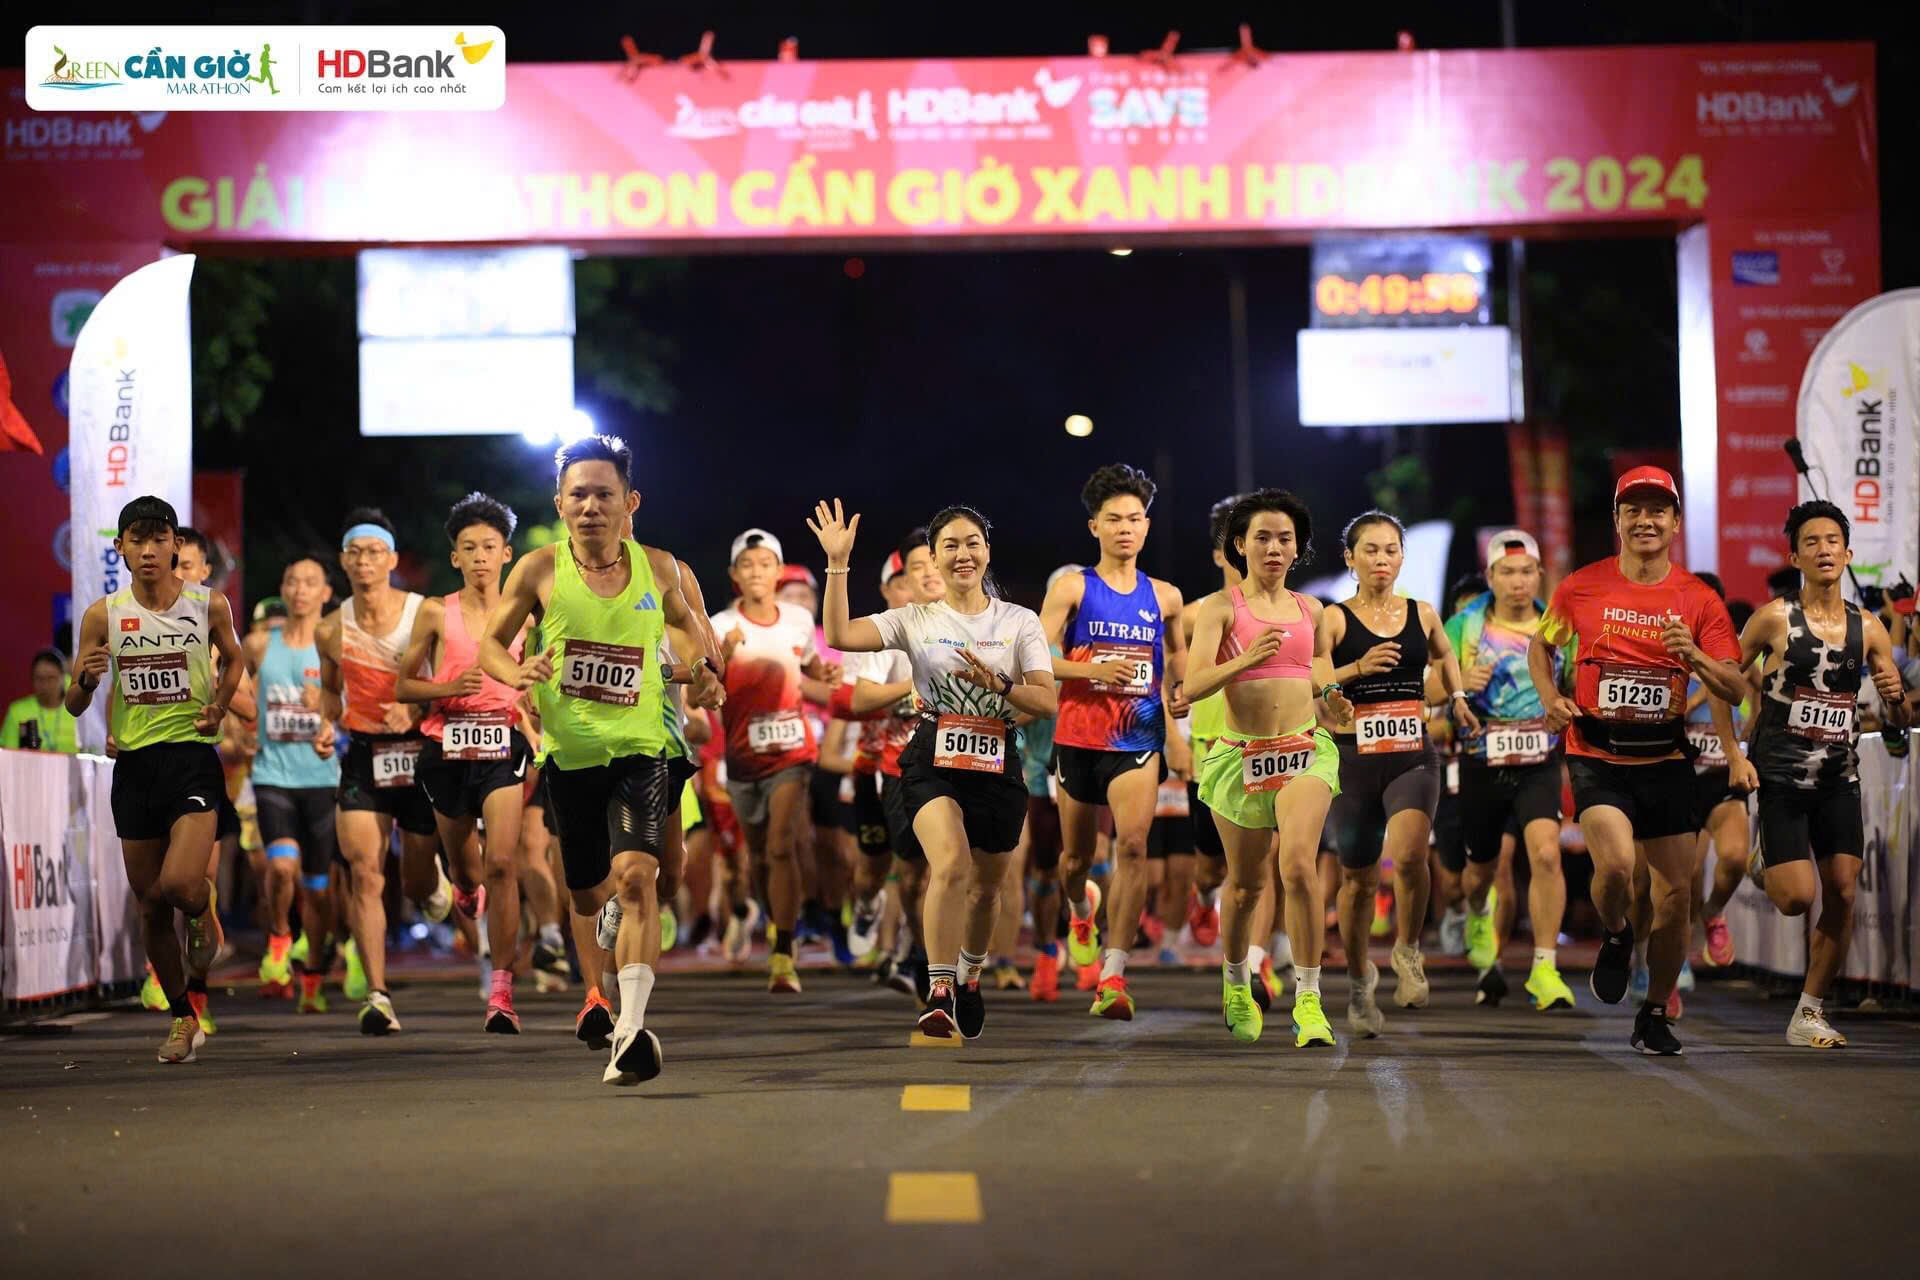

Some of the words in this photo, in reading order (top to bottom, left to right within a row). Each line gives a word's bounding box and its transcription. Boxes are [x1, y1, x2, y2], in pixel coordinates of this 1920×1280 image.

[5, 116, 132, 146] HDBank
[1032, 164, 1229, 224] XANH
[1544, 154, 1708, 214] 2024
[107, 368, 136, 488] HDBank
[1855, 398, 1882, 523] HDBank
[1603, 608, 1666, 627] HDBank
[120, 633, 201, 648] ANTA
[129, 670, 180, 691] 51061
[572, 660, 635, 688] 51002
[1608, 684, 1663, 706] 51236
[1364, 718, 1417, 738] 50045
[1800, 705, 1846, 728] 51140
[452, 727, 503, 745] 51050
[945, 732, 998, 756] 50158
[1497, 735, 1541, 751] 51001
[1252, 750, 1309, 777] 50047
